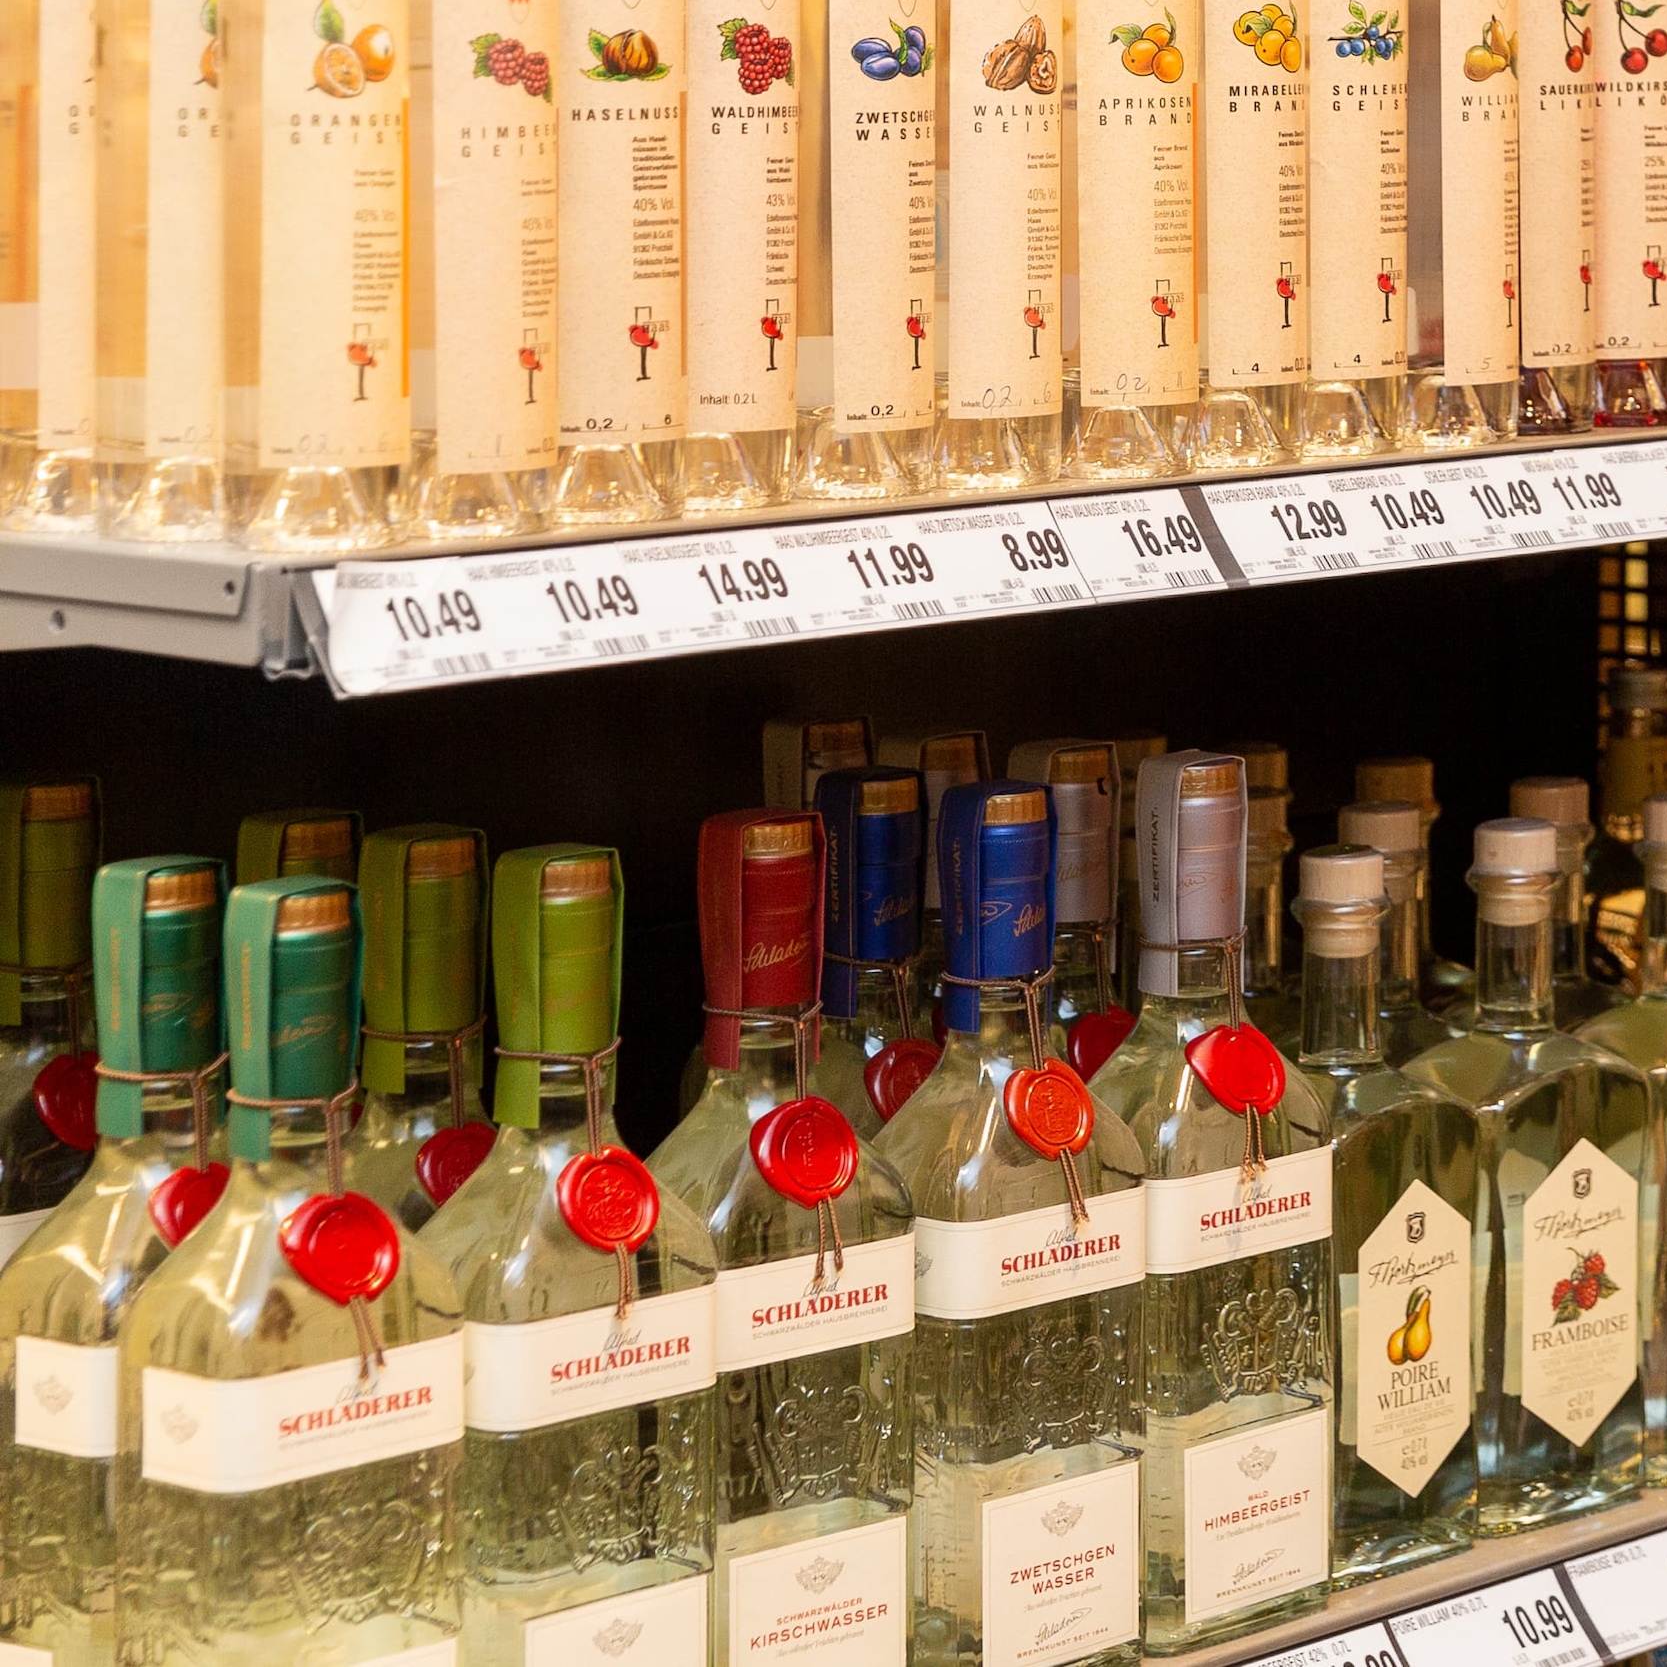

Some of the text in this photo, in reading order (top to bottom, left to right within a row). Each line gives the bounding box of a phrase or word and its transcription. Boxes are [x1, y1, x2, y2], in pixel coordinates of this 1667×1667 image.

[572, 107, 678, 121] HASELNUSS
[855, 110, 935, 124] ZWETSCHGE
[974, 104, 1060, 116] WALNUSS
[1099, 97, 1191, 110] APRIKOSEN
[1099, 114, 1192, 126] BRAND
[855, 126, 935, 141] WASSE
[1370, 488, 1446, 531] 10.49
[1469, 478, 1542, 521] 10.49
[1552, 472, 1623, 512] 11.99
[1121, 514, 1202, 558] 16.49
[1270, 499, 1347, 541] 12.99
[846, 542, 935, 589] 11.99
[1000, 528, 1069, 572] 8.99
[546, 574, 639, 624] 10.49
[698, 556, 788, 605] 14.99
[386, 589, 481, 642] 10.49
[1200, 1191, 1312, 1234] SCHLADERER
[1001, 1233, 1122, 1277] SCHLADERER
[751, 1283, 889, 1329] SCHLADERER
[1531, 1313, 1629, 1351] FRAMBOISE
[550, 1336, 692, 1385] SCHLADERER
[1390, 1361, 1439, 1390] POIRE
[279, 1386, 434, 1439] SCHLADERER
[1377, 1377, 1452, 1411] WILLIAM
[1204, 1489, 1312, 1532] HIMBEERGEIST
[1246, 1490, 1271, 1503] WALD
[1010, 1543, 1116, 1586] ZWETSCHGEN
[1032, 1566, 1095, 1596] WASSER
[750, 1604, 888, 1650] KIRSCHWASSER
[776, 1597, 863, 1626] SCHWARZWÄLDER
[1501, 1593, 1574, 1650] 10.99
